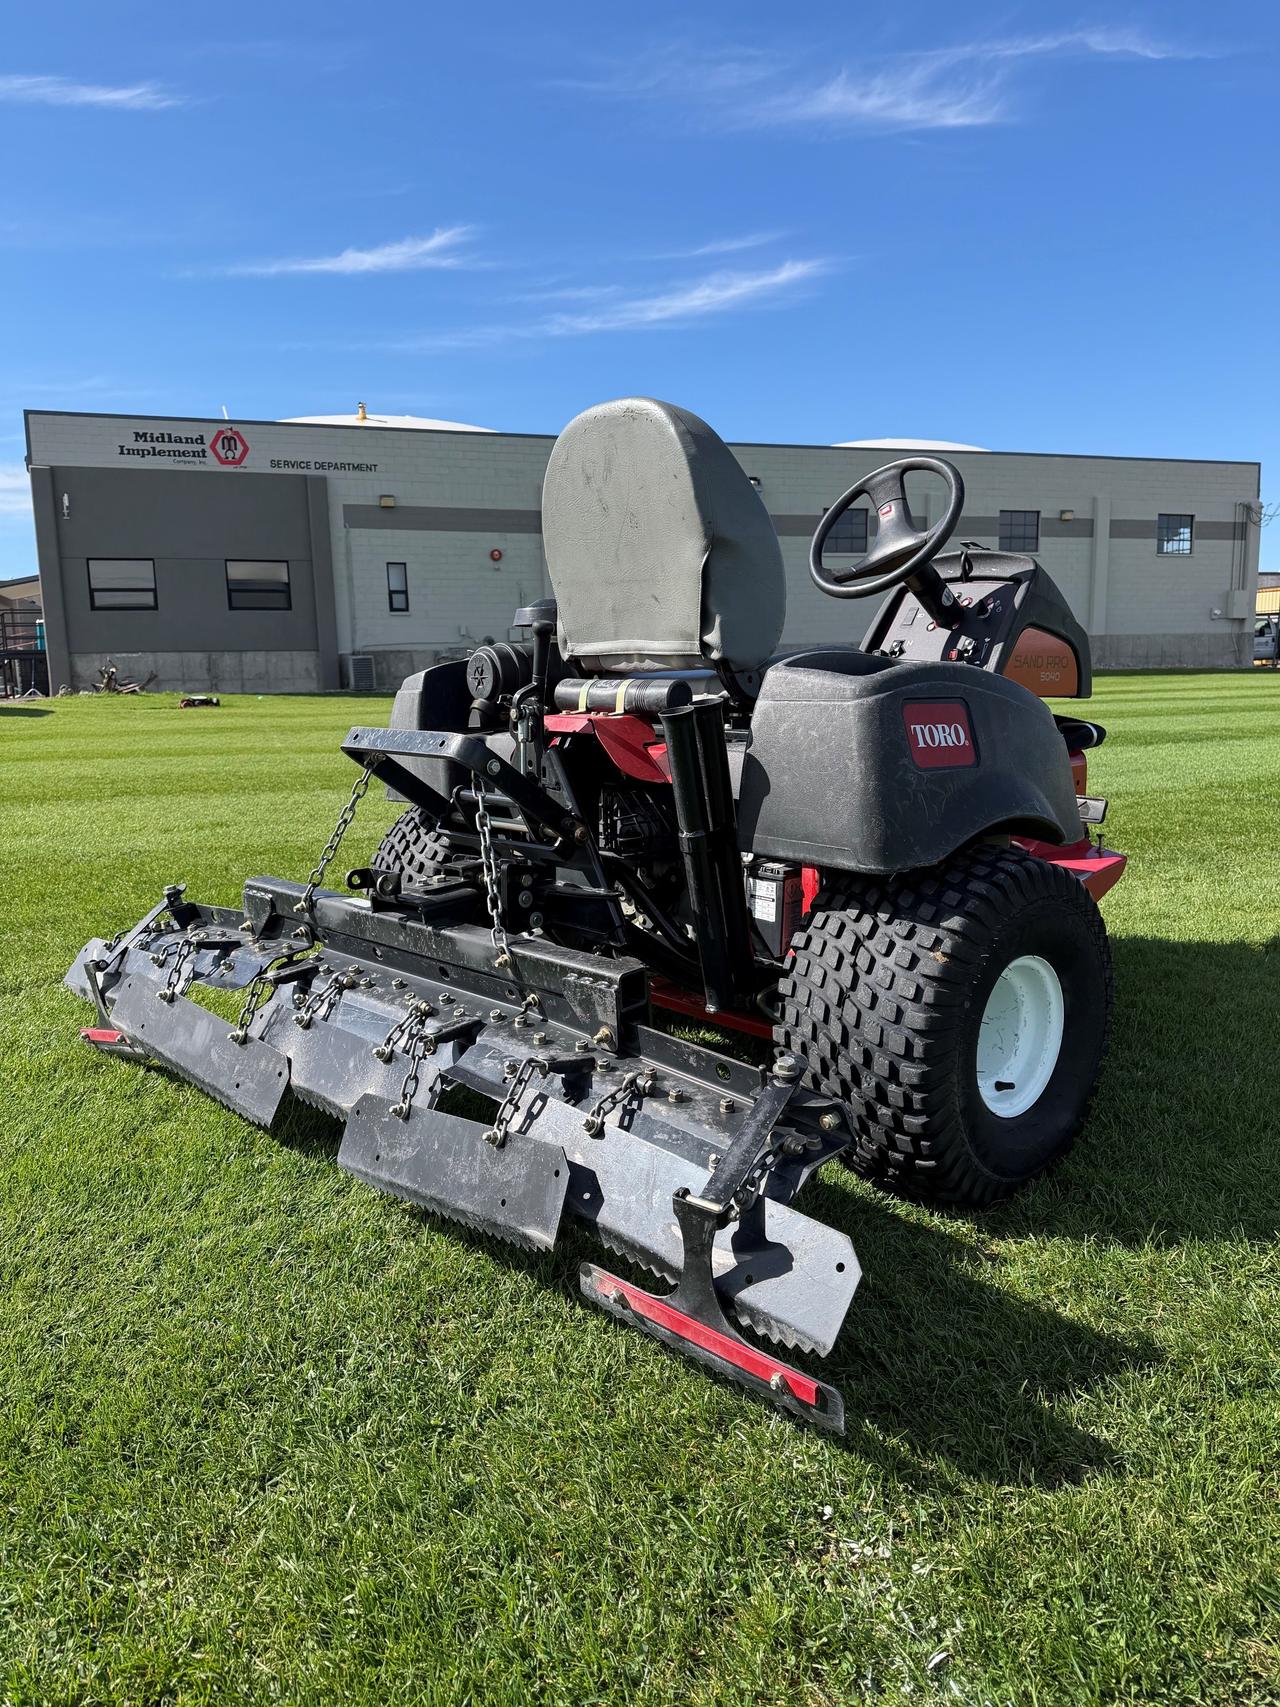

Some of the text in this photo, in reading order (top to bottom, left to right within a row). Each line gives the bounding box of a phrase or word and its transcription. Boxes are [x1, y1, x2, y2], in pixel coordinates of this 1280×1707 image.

[133, 431, 206, 445] Midland
[118, 445, 208, 459] Implement
[270, 459, 378, 472] SERVICE DEPARTMENT
[1014, 655, 1070, 669] SAND PRO
[1040, 671, 1061, 681] 5040
